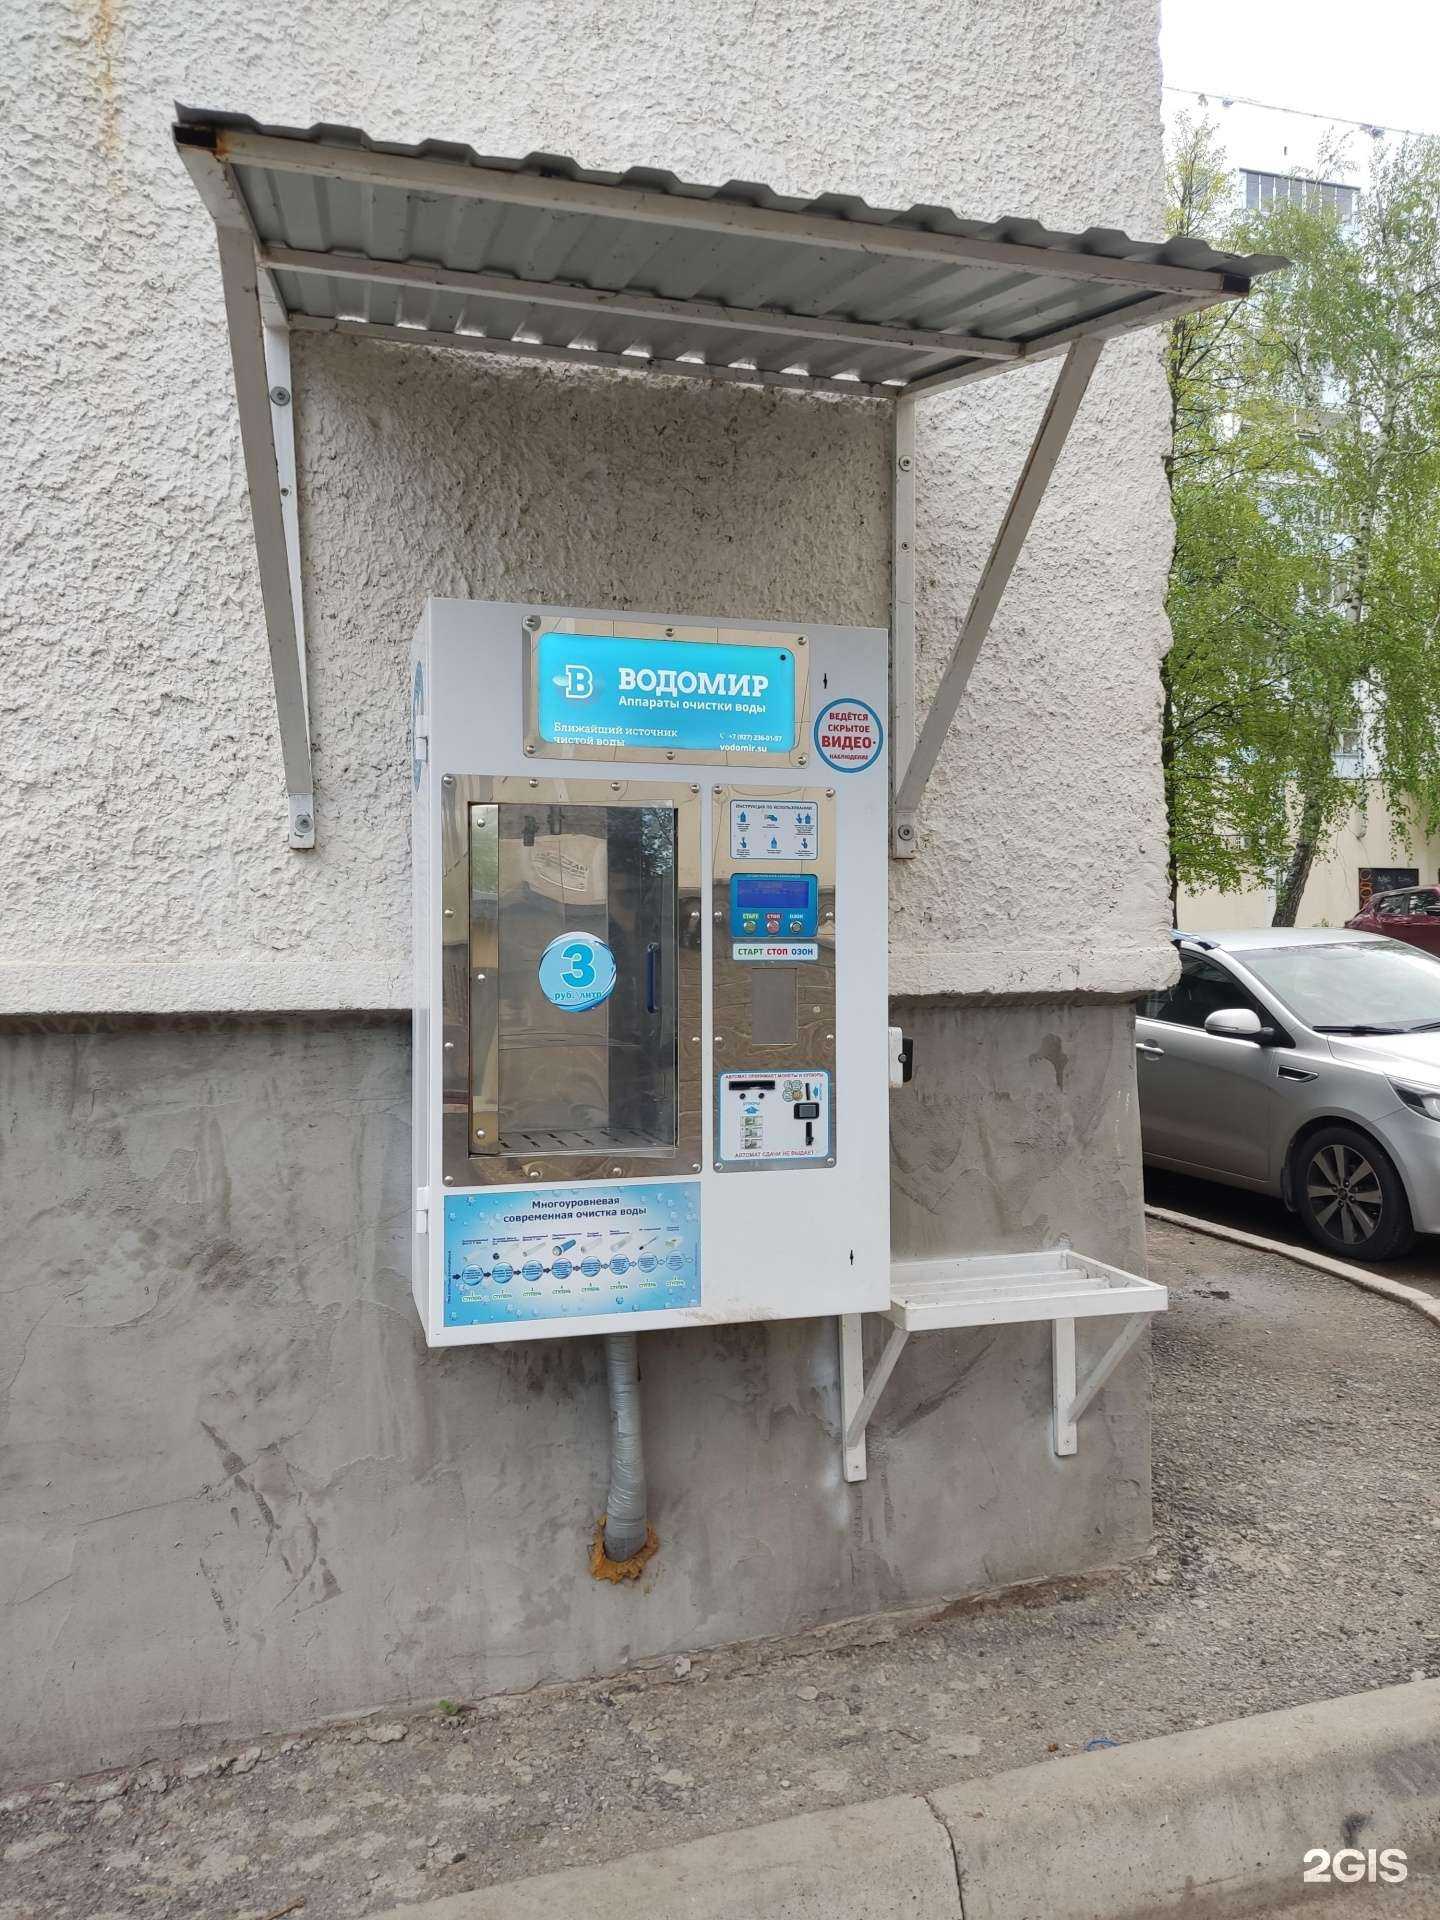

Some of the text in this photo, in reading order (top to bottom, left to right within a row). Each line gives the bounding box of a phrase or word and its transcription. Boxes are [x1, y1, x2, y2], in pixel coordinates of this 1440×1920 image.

[618, 667, 769, 698] ВОДОМИР
[618, 695, 766, 715] Аппараты очистки воды
[829, 712, 869, 722] ВЕДЁТСЯ
[553, 721, 679, 738] Ближайший источник
[827, 724, 871, 733] СКРЫТОЕ
[553, 736, 625, 747] чистой воды
[719, 743, 768, 753] vodomir.su
[738, 948, 813, 956] СТАРТ СТОП ОЗОН
[560, 942, 597, 989] 3
[532, 1196, 621, 1210] Многоуровневая
[503, 1205, 648, 1224] современная очистка воды
